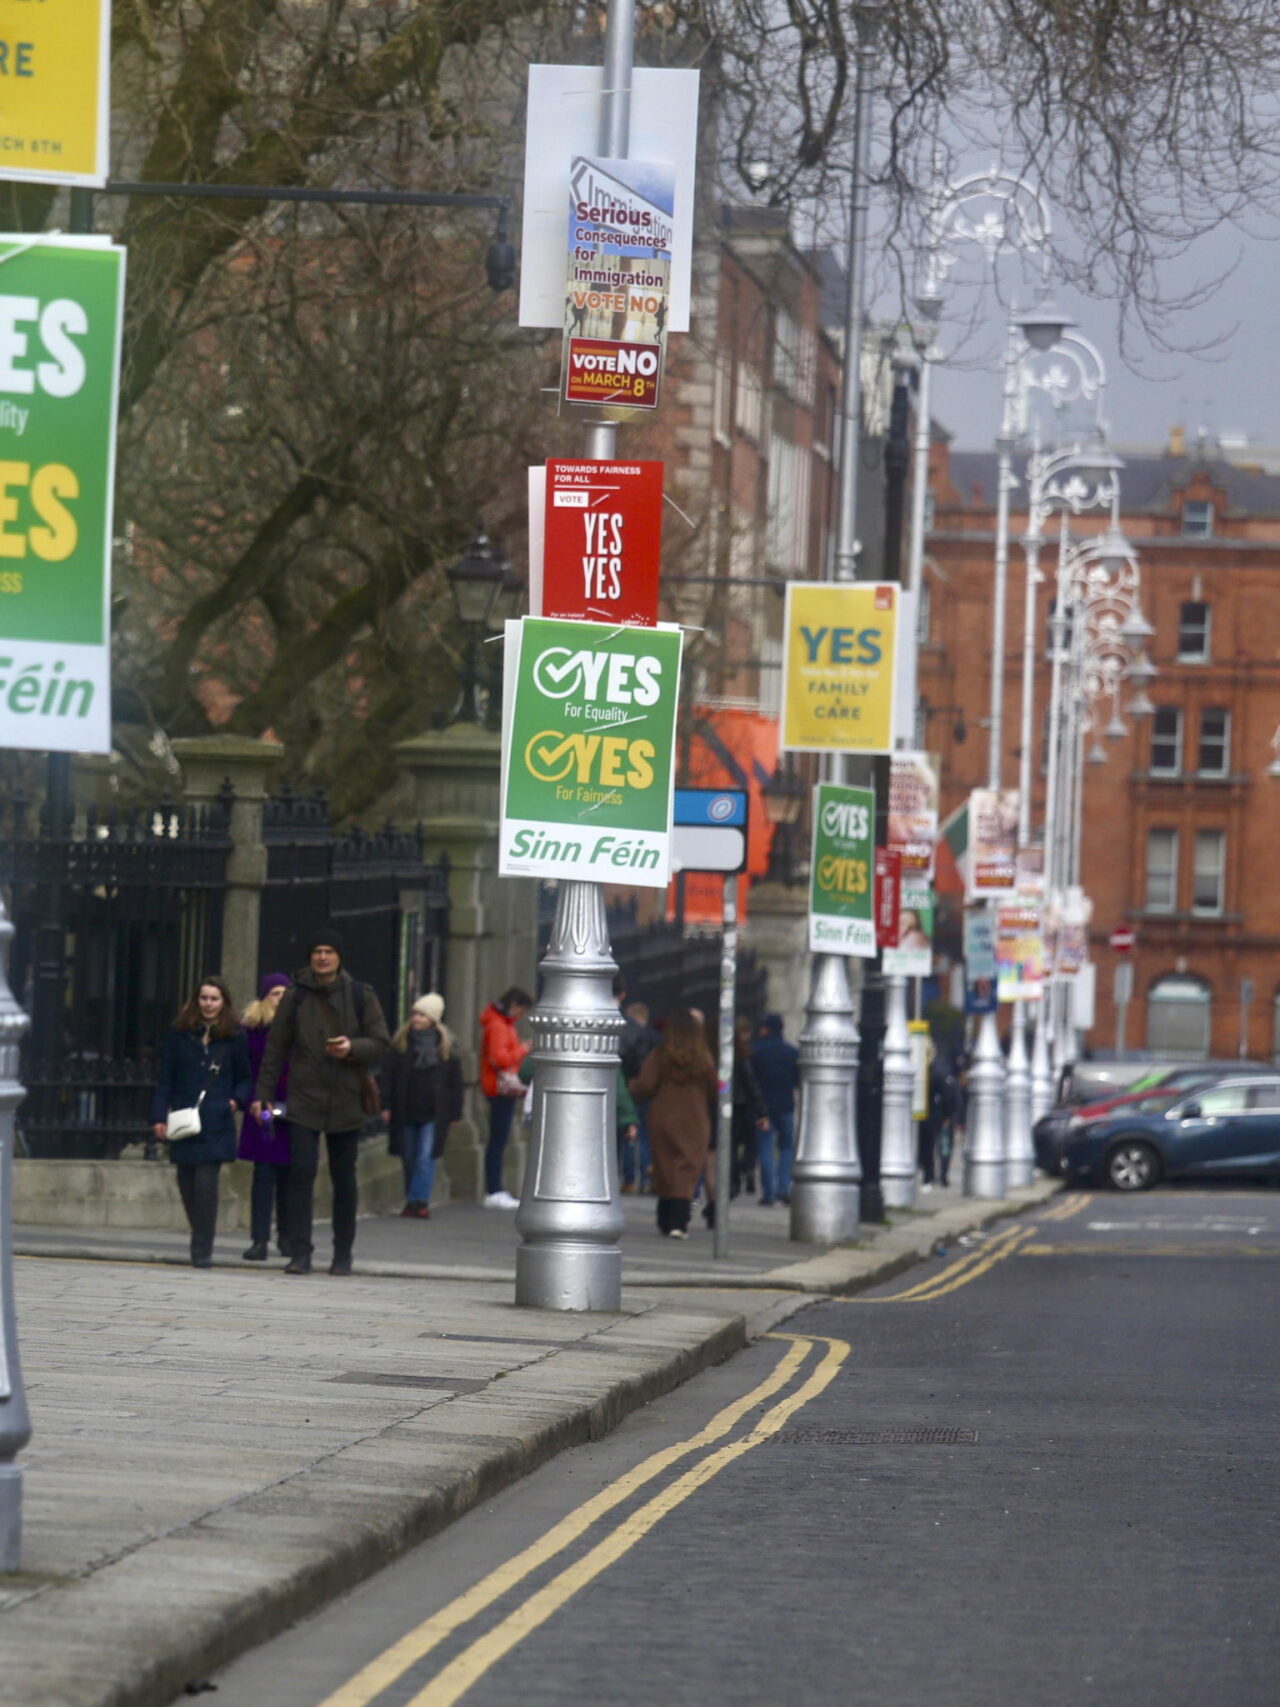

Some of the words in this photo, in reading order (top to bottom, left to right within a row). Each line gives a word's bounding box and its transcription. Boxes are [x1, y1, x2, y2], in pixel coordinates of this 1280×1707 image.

[576, 201, 651, 227] Serious
[575, 228, 667, 249] Consequences
[575, 246, 596, 261] for
[575, 266, 664, 288] Immigration
[572, 290, 625, 312] VOTE
[630, 296, 659, 313] NO
[572, 354, 616, 372] VOTE
[617, 349, 658, 376] NO
[583, 372, 631, 388] MARCH
[554, 465, 598, 475] TOWARDS
[599, 466, 641, 475] FAIRNESS
[554, 475, 573, 483] FOR
[574, 475, 590, 483] ALL
[559, 495, 583, 504] VOTE
[583, 512, 623, 556] YES
[582, 557, 622, 600] YES
[799, 626, 882, 665] YES
[578, 650, 662, 707] YES
[808, 681, 870, 696] FAMILY
[565, 702, 582, 717] For
[585, 704, 629, 722] Equality
[814, 706, 862, 720] CARE
[573, 734, 656, 790] YES
[556, 785, 574, 800] For
[577, 787, 623, 805] Fairness
[509, 829, 583, 862] Sinn
[589, 836, 661, 869] Féin
[814, 921, 843, 941] Sinn
[846, 924, 873, 945] Féin
